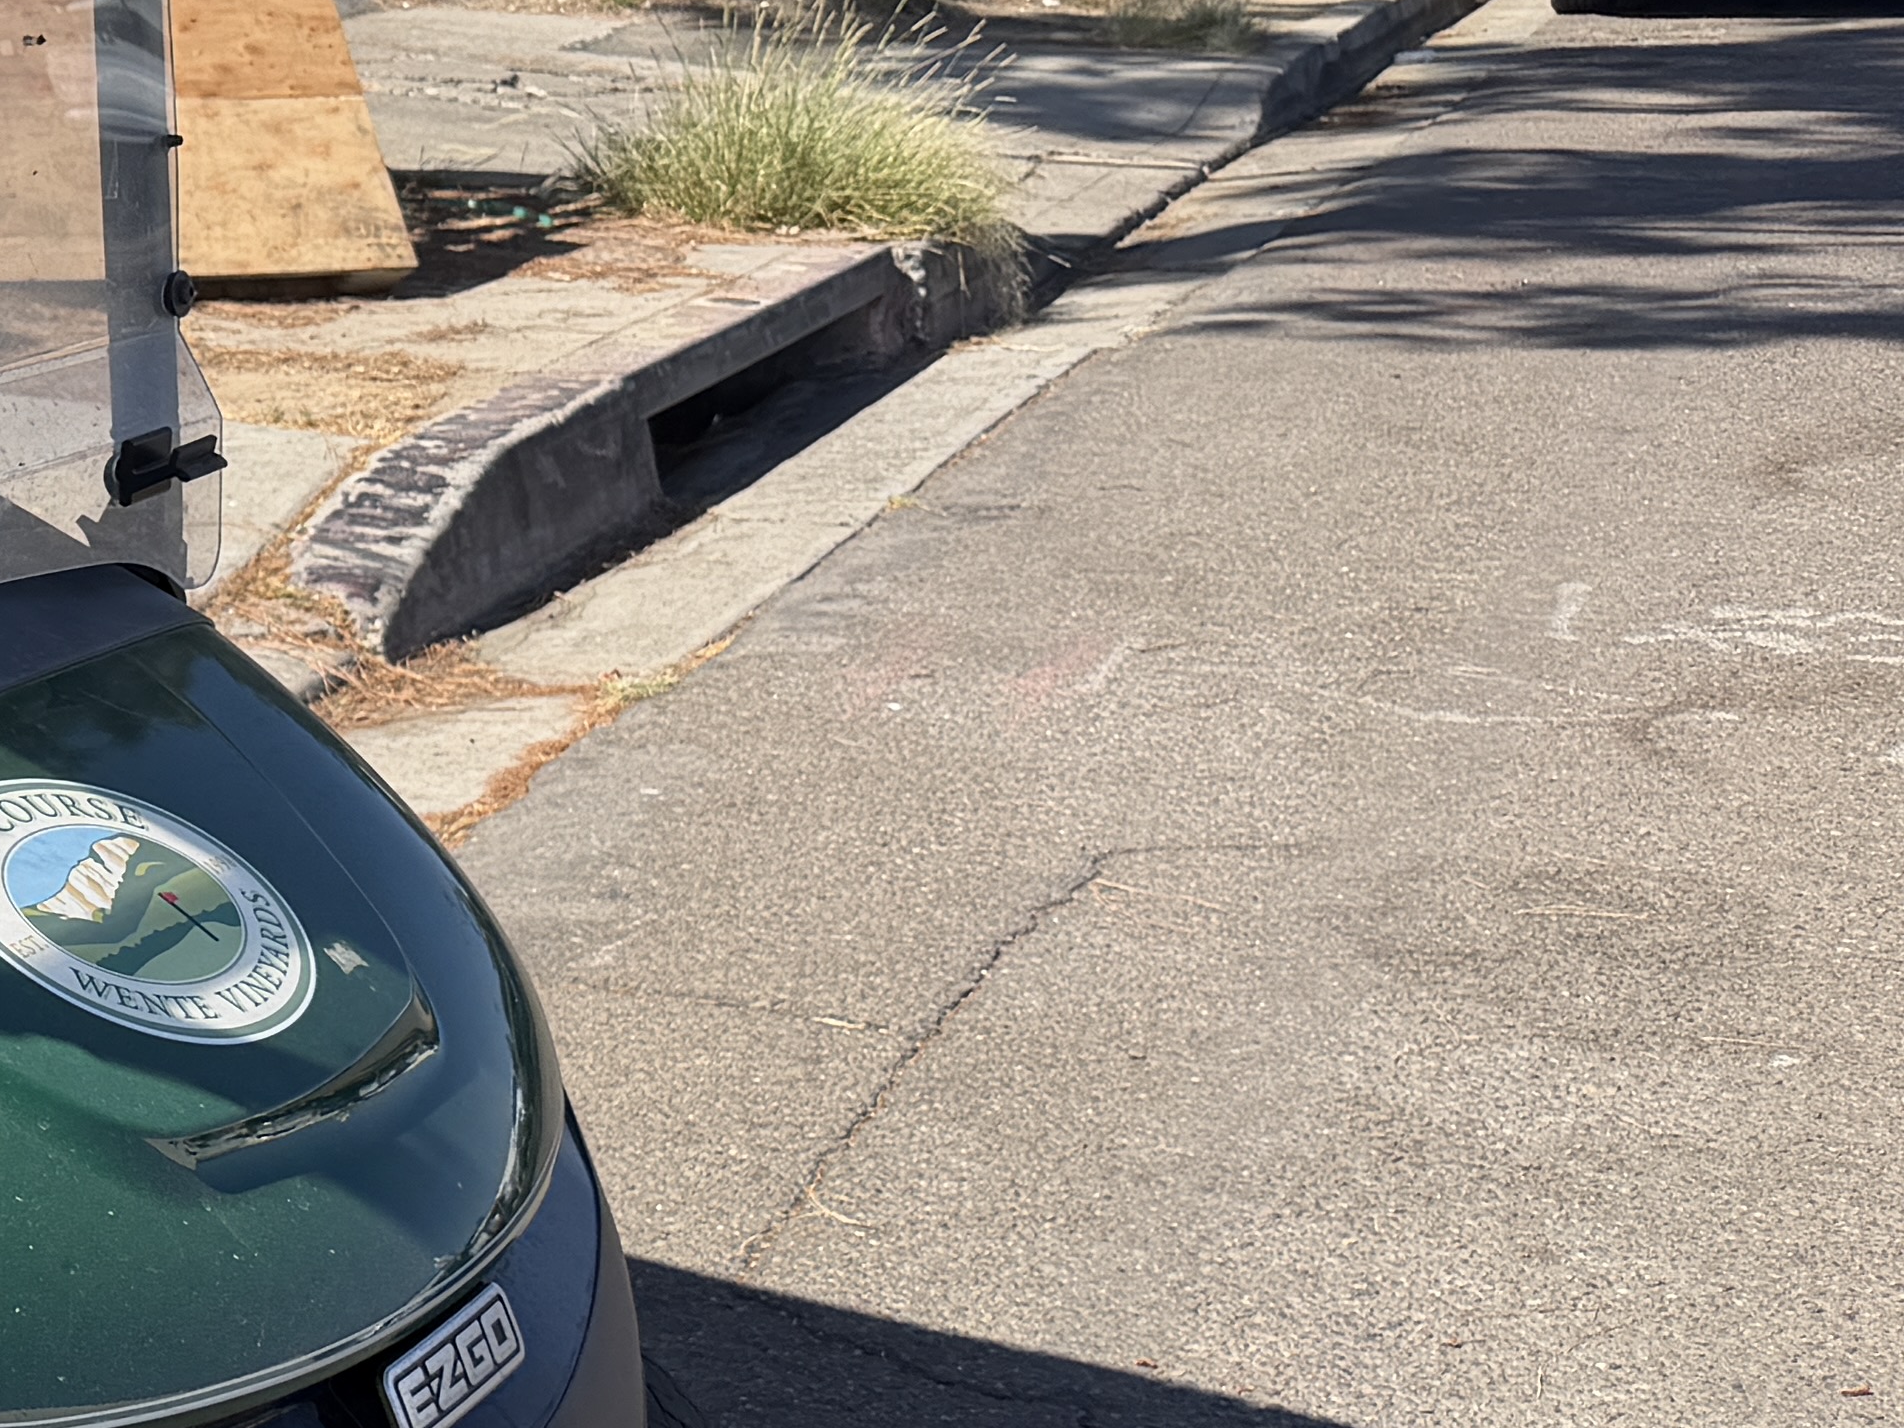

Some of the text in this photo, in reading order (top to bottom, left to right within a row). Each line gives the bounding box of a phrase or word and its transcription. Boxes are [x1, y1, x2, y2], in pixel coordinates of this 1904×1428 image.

[9, 935, 50, 959] EST.
[69, 887, 291, 1020] WENTE VINEYARDS
